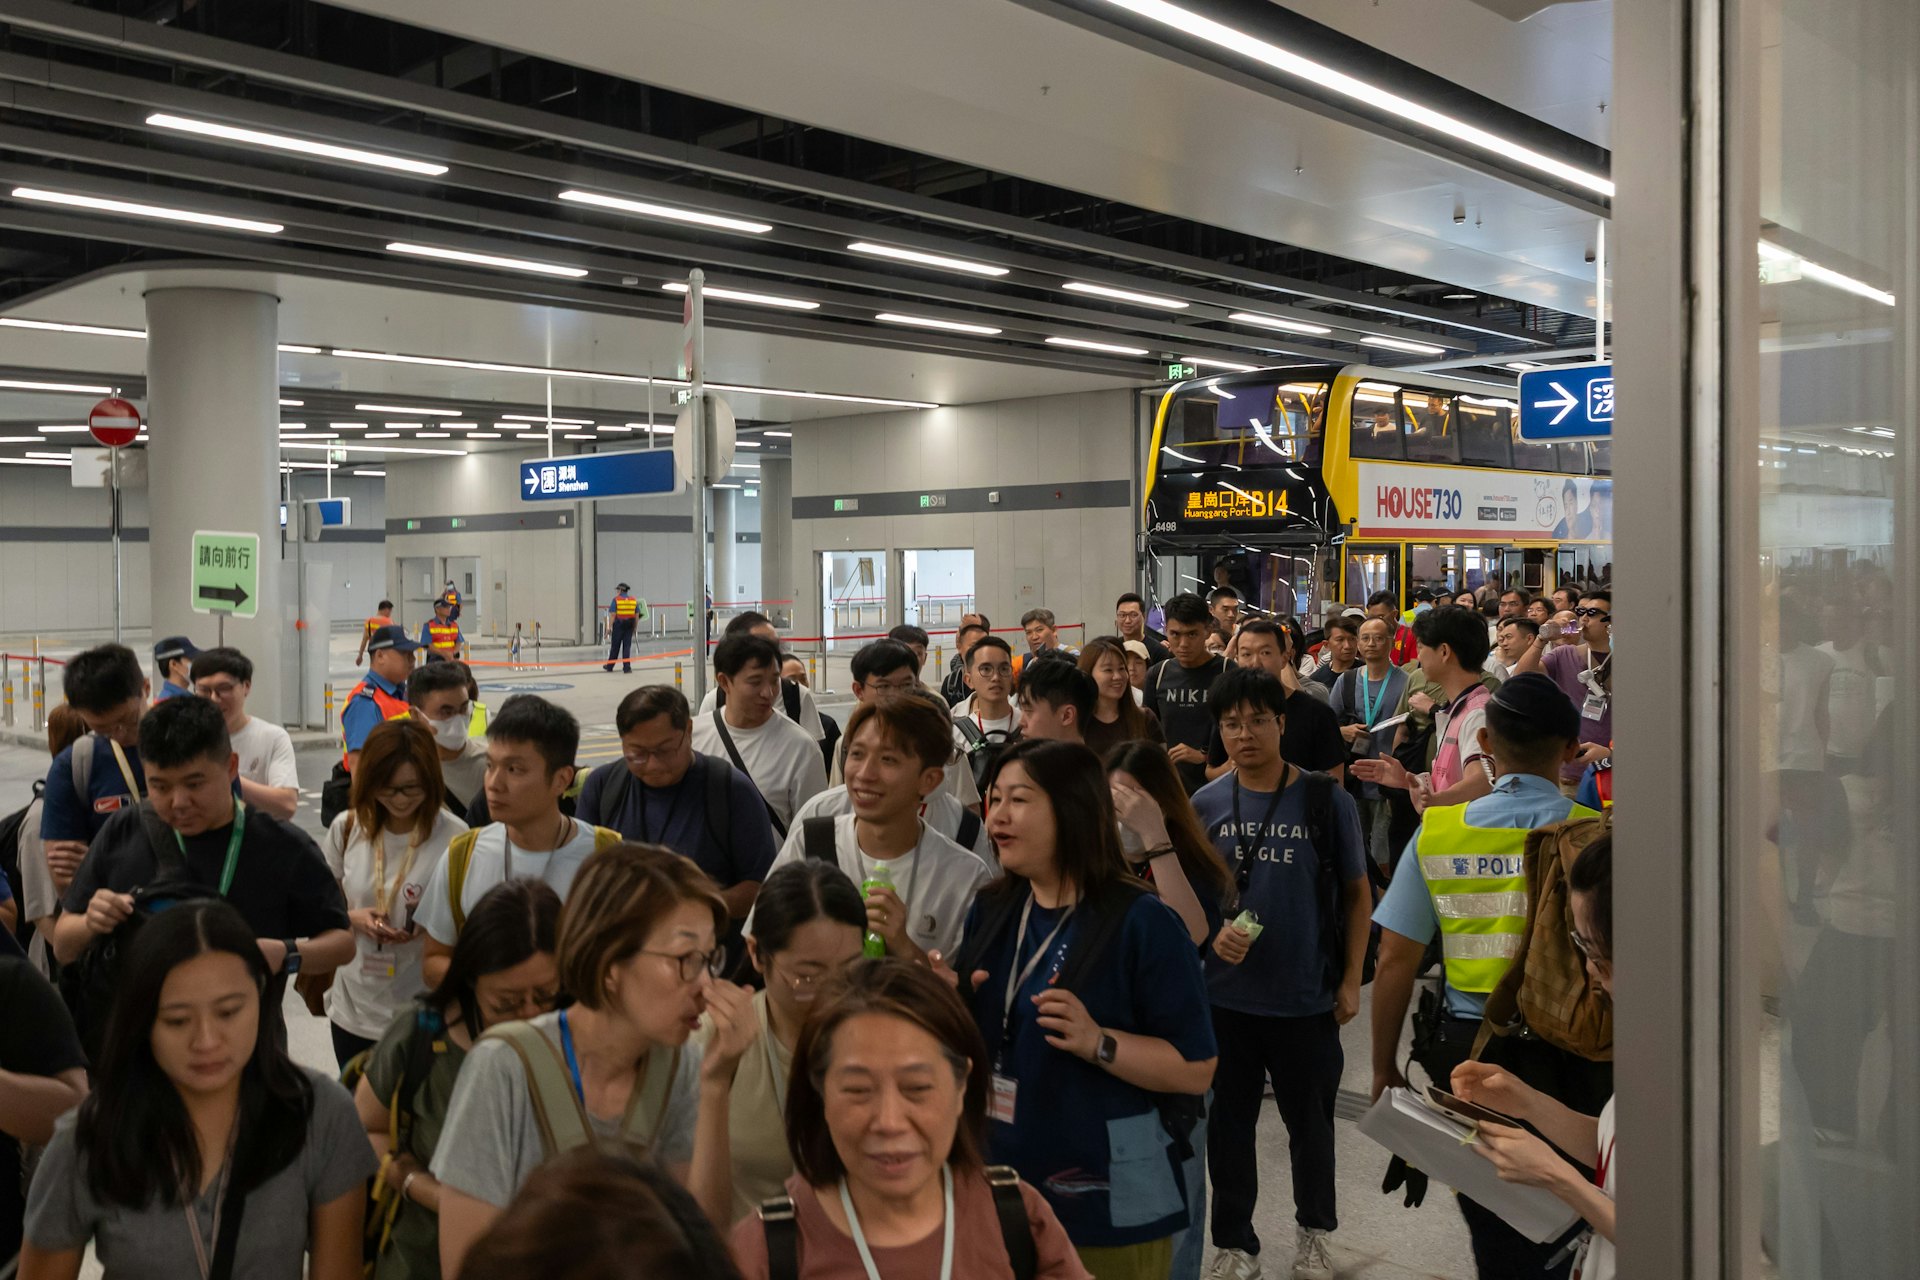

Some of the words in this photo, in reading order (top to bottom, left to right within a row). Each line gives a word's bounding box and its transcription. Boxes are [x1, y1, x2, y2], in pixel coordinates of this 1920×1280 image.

[558, 480, 588, 492] Shenzhen
[1187, 491, 1250, 508] 皇崗口岸
[1251, 489, 1288, 517] B14
[1377, 486, 1462, 520] HOUSE730
[1184, 508, 1228, 518] Huanggang
[1229, 507, 1251, 517] Port
[1155, 521, 1177, 532] 6498
[199, 545, 250, 570] 請向前行
[1219, 822, 1309, 839] AMEICA
[1235, 845, 1295, 864] EGLE
[1452, 857, 1469, 875] 警
